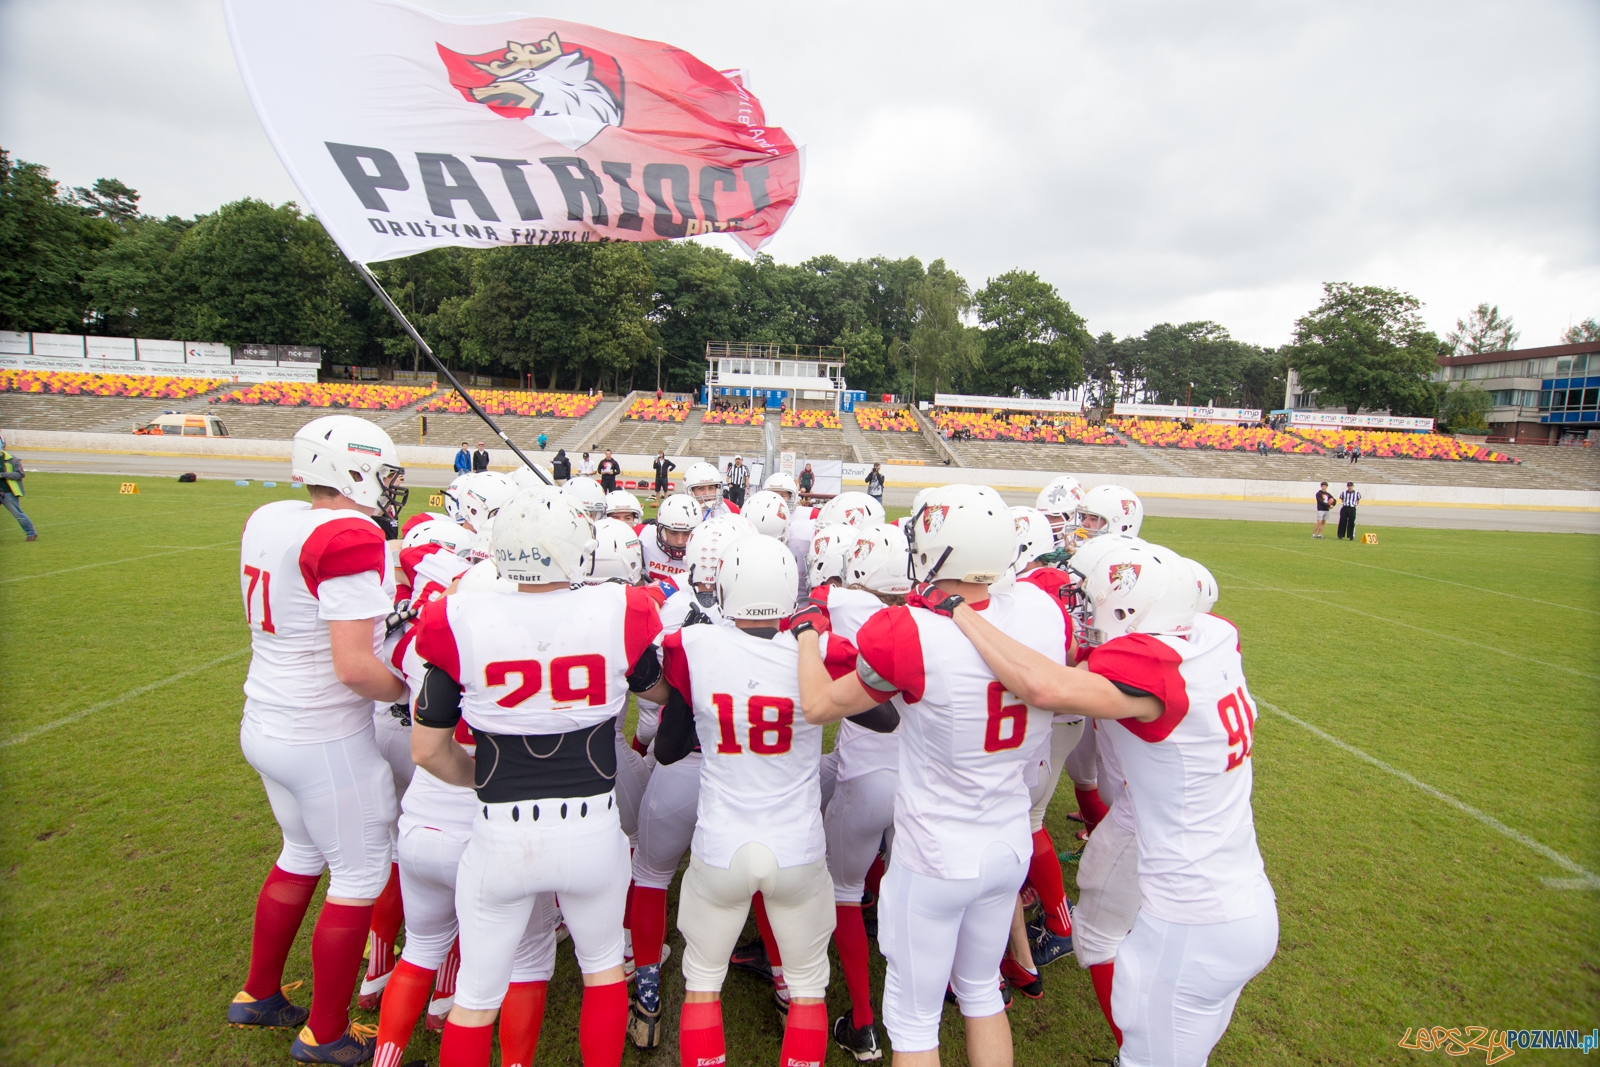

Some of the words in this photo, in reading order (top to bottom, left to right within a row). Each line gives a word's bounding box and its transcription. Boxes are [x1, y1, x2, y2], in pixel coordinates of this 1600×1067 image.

[324, 140, 770, 237] PATRIOCI
[367, 217, 499, 240] DRUŻYNA
[121, 483, 133, 493] 30
[430, 496, 440, 506] 40
[1367, 534, 1377, 544] 30
[471, 549, 489, 560] Ridde
[649, 561, 686, 575] PATRIO
[507, 573, 541, 581] schutt
[243, 563, 276, 635] 71
[745, 608, 778, 616] XENITH
[484, 653, 606, 708] 29
[712, 692, 794, 756] 18
[984, 681, 1028, 753] 6
